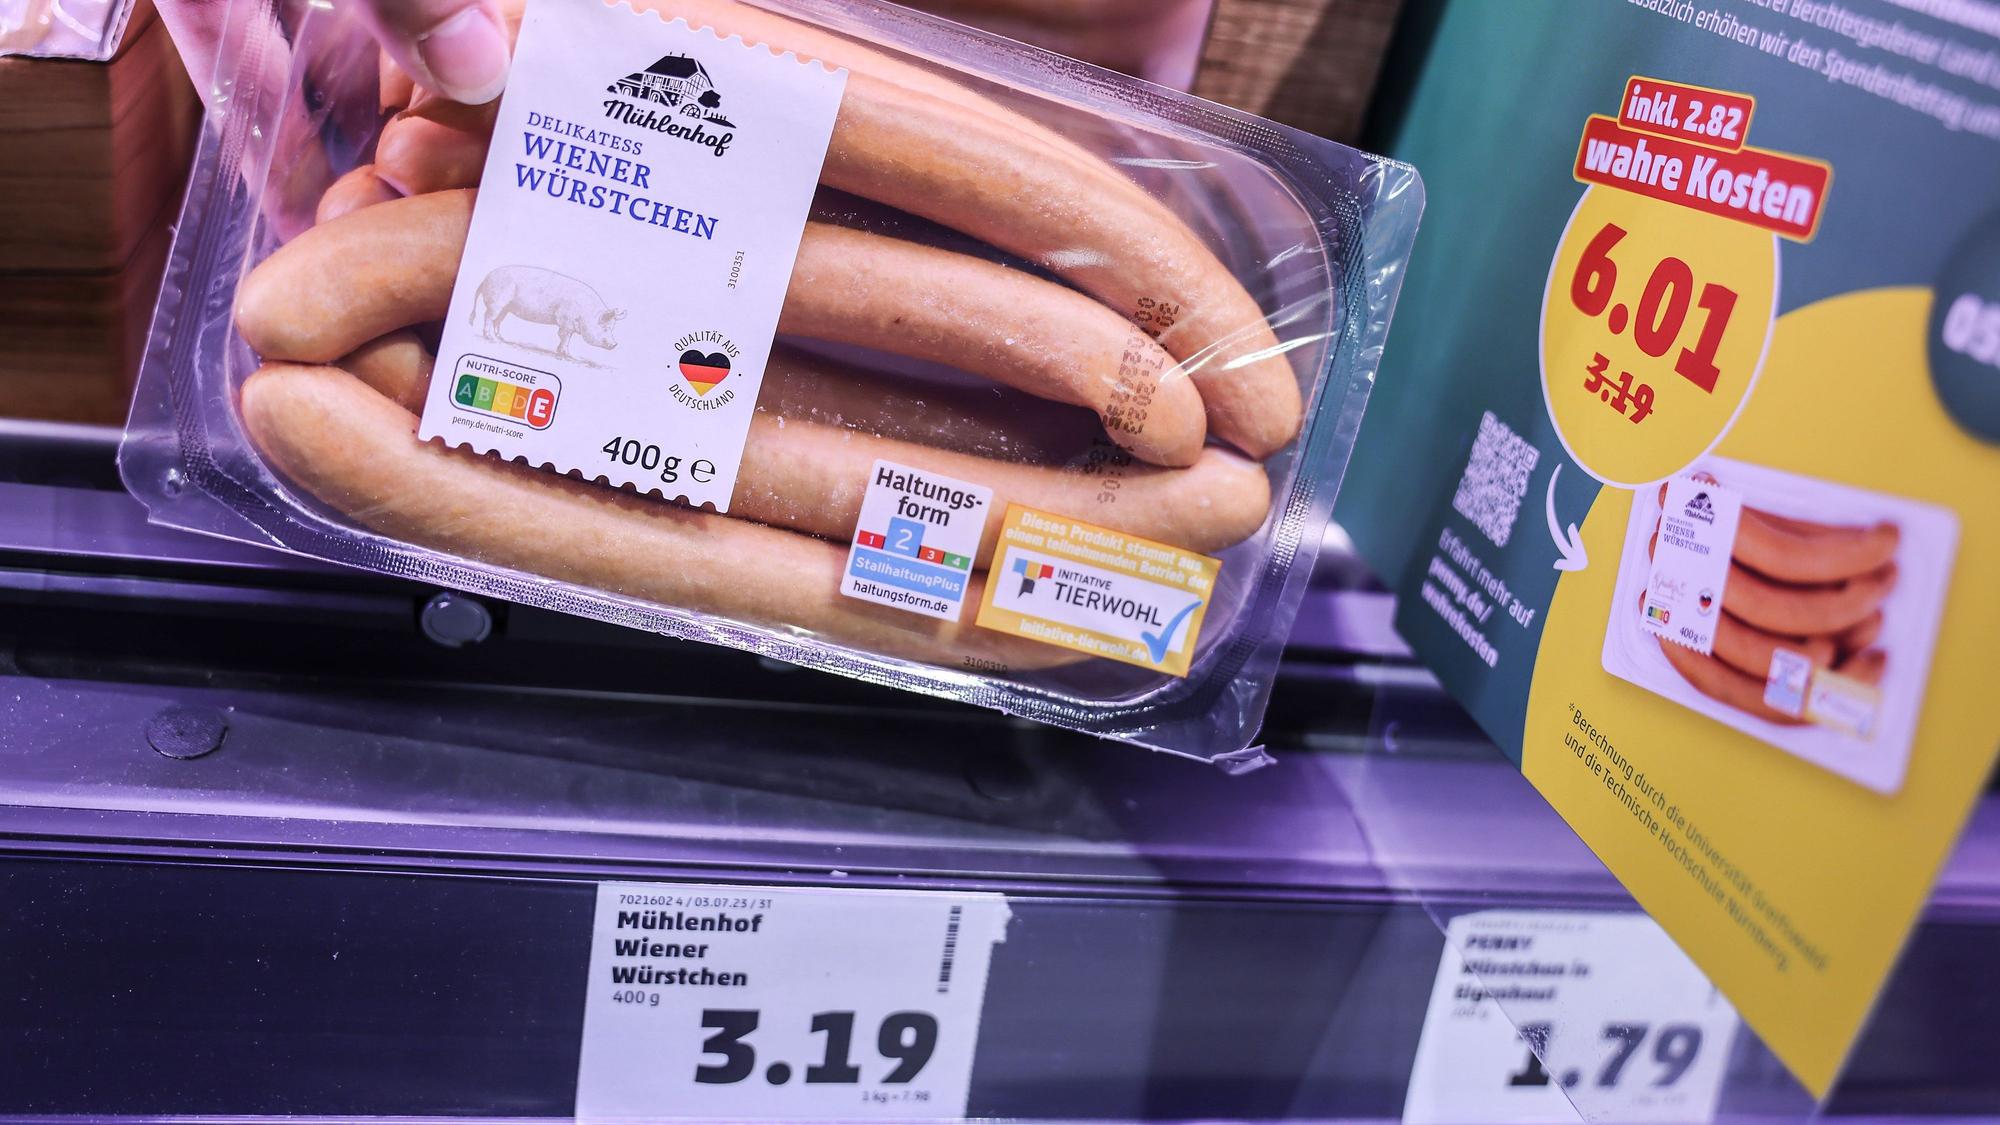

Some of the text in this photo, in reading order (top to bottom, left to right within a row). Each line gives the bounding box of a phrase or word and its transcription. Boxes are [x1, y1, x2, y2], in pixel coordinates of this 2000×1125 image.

[1695, 9, 1757, 46] erhöhen
[1760, 31, 1788, 57] wir
[1788, 38, 1822, 70] den
[527, 111, 643, 155] DELIKATESS
[603, 99, 733, 157] Mühlenhof
[1626, 84, 1743, 142] inkl. 2.82
[523, 131, 651, 189] WIENER
[1584, 137, 1814, 227] wahre Kosten
[515, 163, 719, 241] WÜRSTCHEN
[728, 250, 745, 289] 3100351
[1570, 222, 1738, 394] 6.01
[674, 330, 740, 358] QUALITÄT AUS
[466, 360, 537, 384] NUTRI-SCORE
[1583, 352, 1655, 424] 3.19
[669, 384, 735, 410] DEUTSCHLAND
[452, 416, 524, 439] penny.de/nutri-score
[876, 467, 983, 510] Haltungs-
[897, 496, 950, 526] form
[895, 528, 913, 550] 2
[927, 550, 935, 560] 3
[1005, 527, 1210, 590] einem teilnehmenden Betrieb der
[1021, 511, 1202, 572] Dieses Produkt stammt aus
[1664, 534, 1710, 555] WÜRSTCHEN
[853, 580, 948, 612] haltungsform.de
[856, 557, 960, 592] StallhaltungPlus
[1058, 568, 1112, 590] INITIATIVE
[1428, 555, 1494, 625] penny.de/
[1438, 526, 1536, 629] Erfahrt mehr auf
[1055, 582, 1162, 627] TIERWOHL
[1421, 580, 1499, 668] wahrekosten
[1564, 732, 1587, 759] und
[1584, 753, 1602, 777] die
[1602, 767, 1659, 833] Technische
[1659, 828, 1726, 904] Hochschule
[1634, 773, 1667, 811] durch
[1666, 804, 1686, 830] die
[617, 911, 764, 932] Mühlenhof
[695, 897, 747, 909] 03.07.23
[759, 899, 773, 909] 3T
[615, 936, 708, 958] Wiener
[612, 965, 748, 986] Würstchen
[613, 990, 660, 1006] 400 g
[694, 1009, 938, 1086] 3.19
[1507, 1022, 1704, 1087] 1.79
